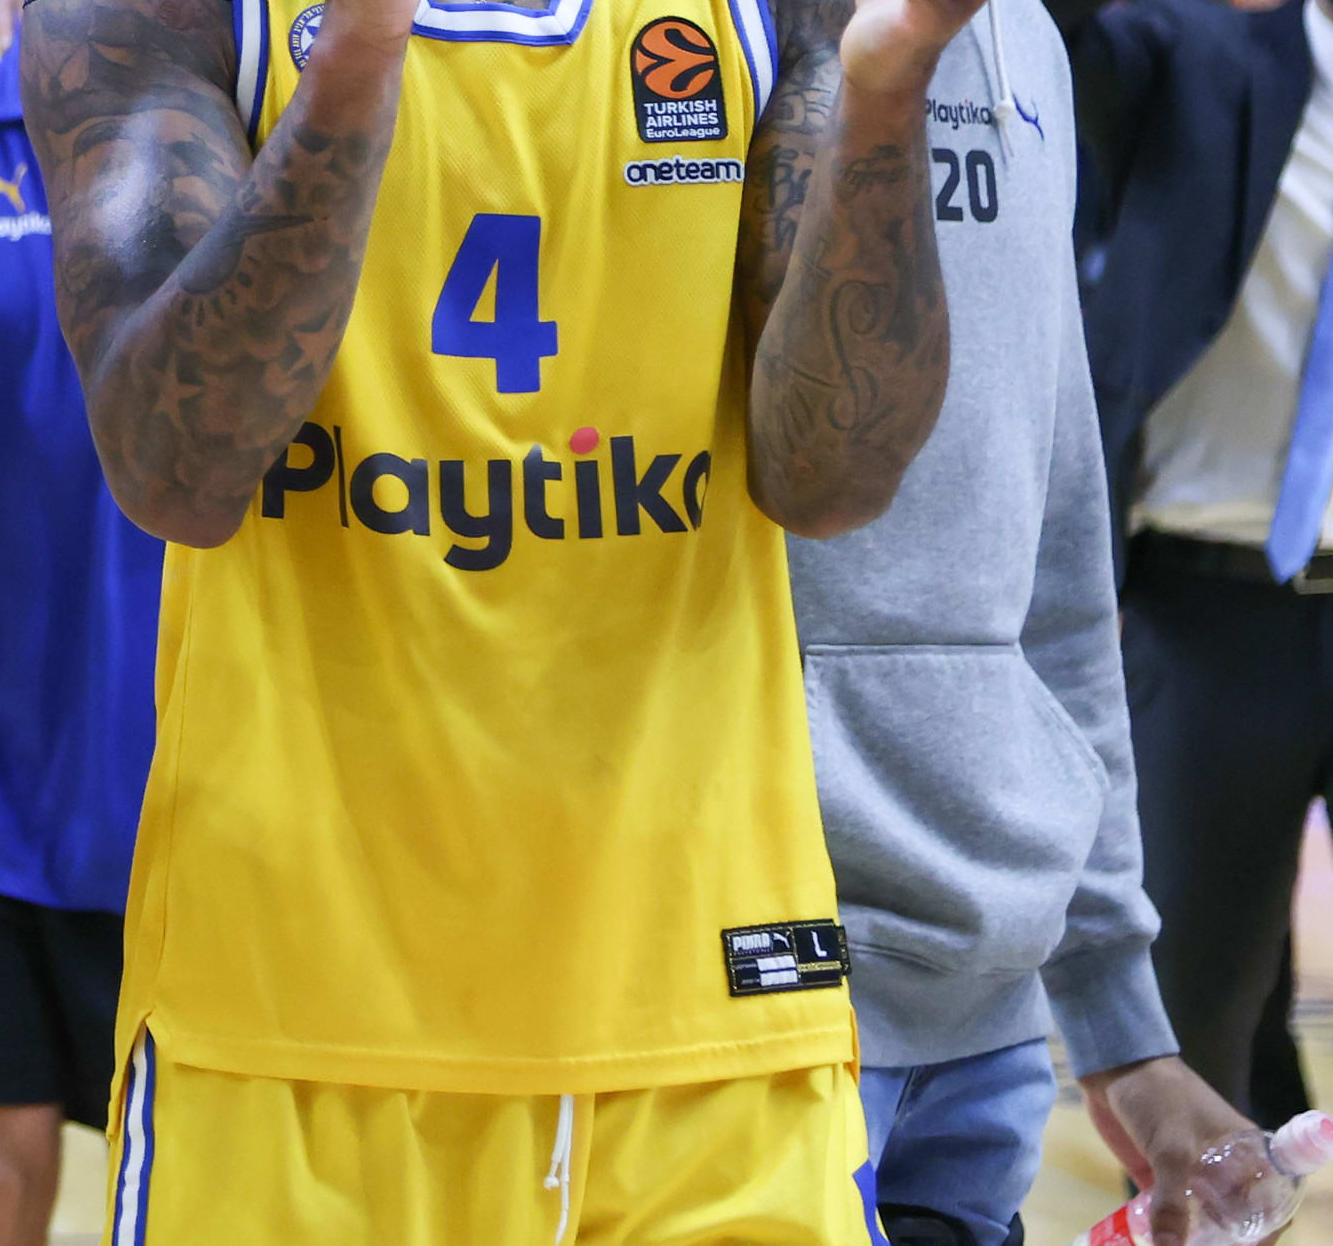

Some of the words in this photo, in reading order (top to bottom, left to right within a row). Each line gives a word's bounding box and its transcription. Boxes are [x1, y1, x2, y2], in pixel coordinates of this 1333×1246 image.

[644, 99, 718, 115] TURKISH
[646, 112, 719, 128] AIRLINES
[646, 127, 721, 139] EuroLeague
[626, 158, 742, 183] oneteam
[931, 147, 999, 223] 20
[432, 213, 558, 394] 4
[732, 932, 771, 952] PUMA
[810, 930, 828, 958] L
